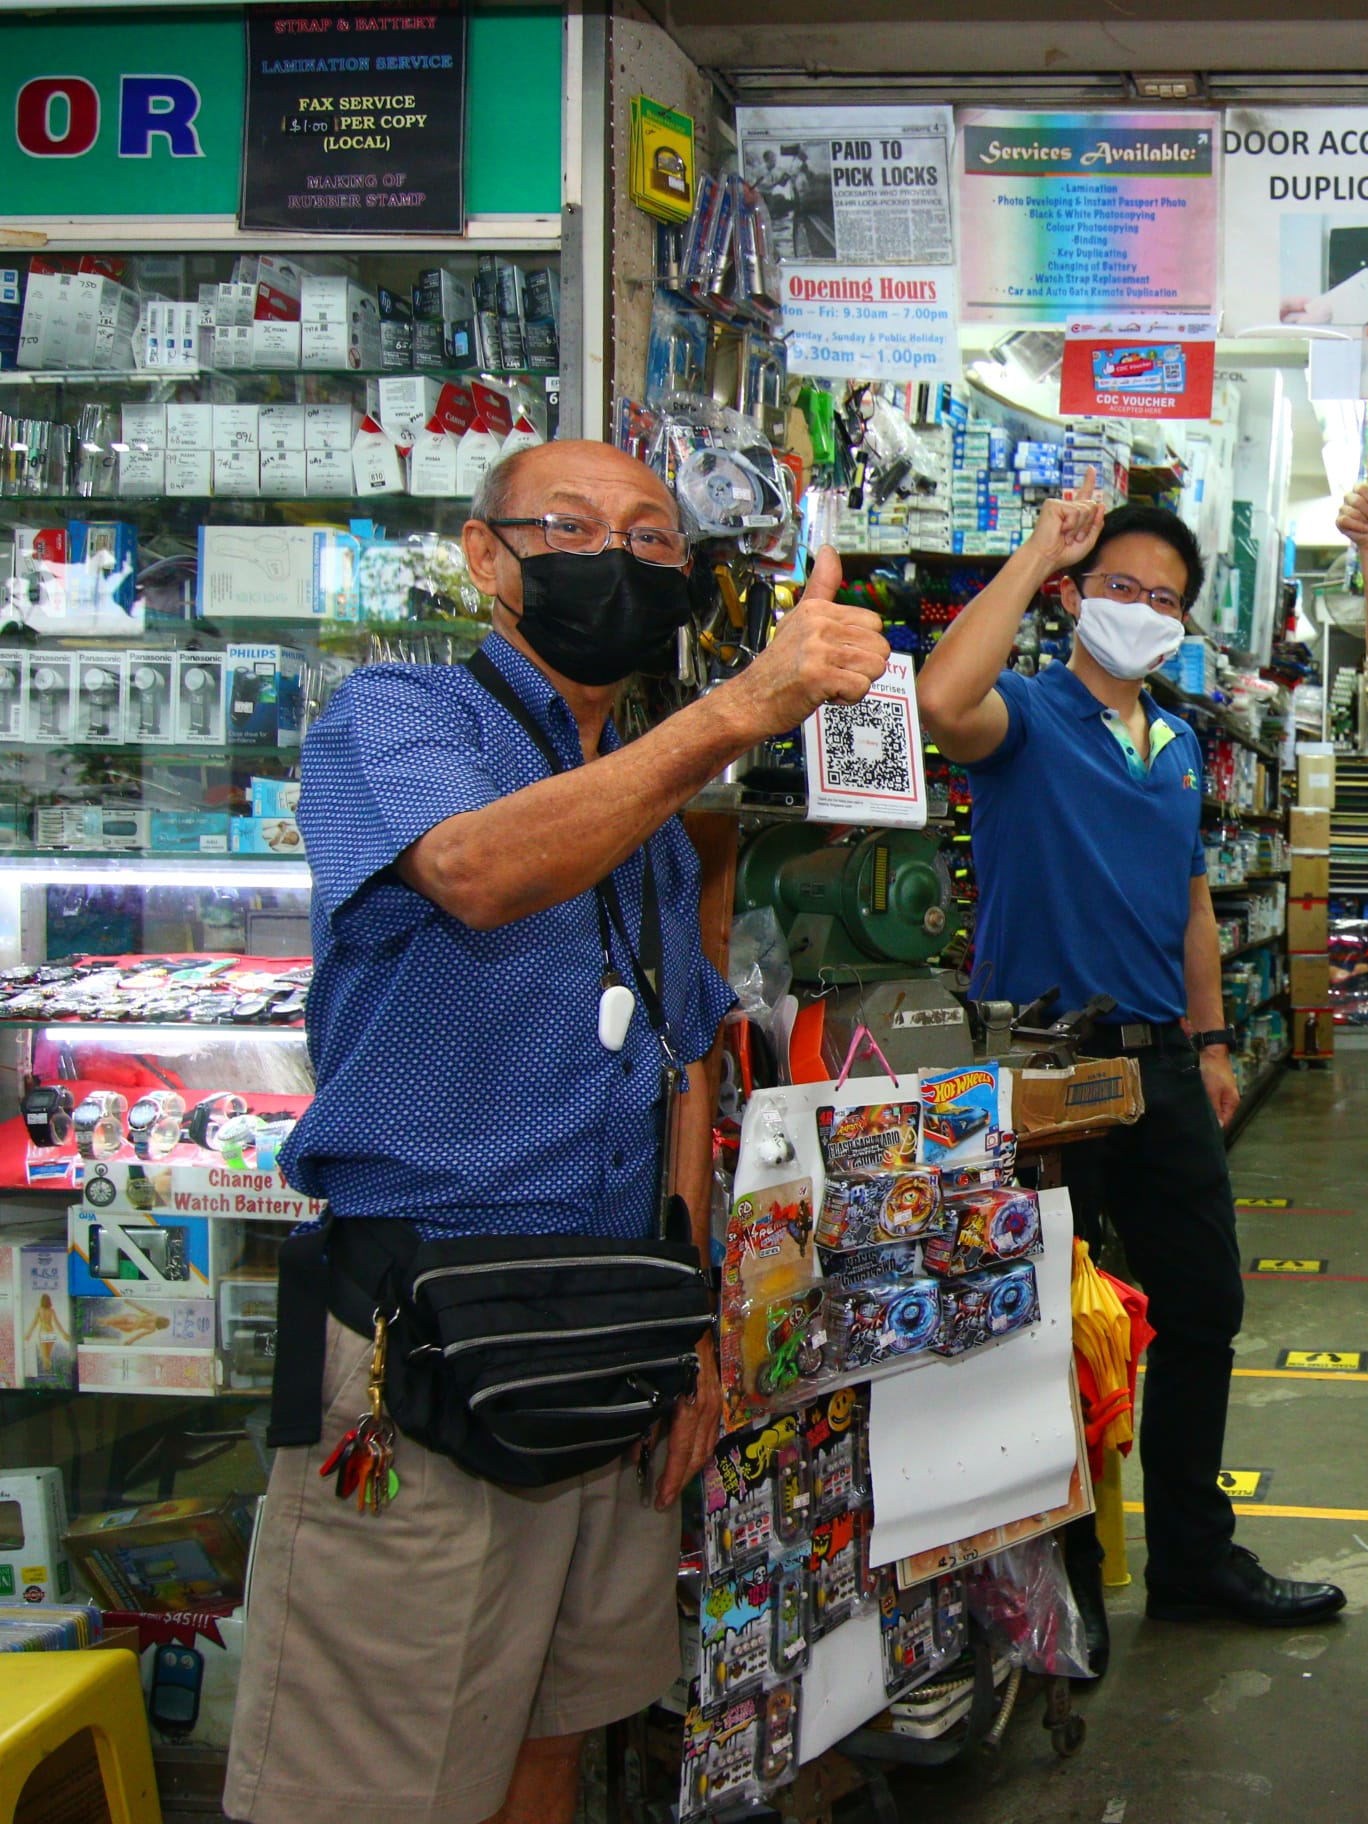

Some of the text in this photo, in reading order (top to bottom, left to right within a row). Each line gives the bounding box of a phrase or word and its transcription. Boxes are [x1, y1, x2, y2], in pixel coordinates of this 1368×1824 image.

[274, 16, 438, 34] STRAP & BATTERY
[262, 54, 453, 74] LAMINATION SERVICE
[299, 95, 415, 112] FAX SERVICE
[340, 114, 428, 131] PER COPY
[323, 136, 391, 152] (LOCAL)
[831, 140, 903, 161] PAID TO
[1222, 130, 1309, 155] DOOR
[979, 140, 1196, 166] Services Available:
[306, 173, 407, 190] MAKING OF
[832, 166, 938, 187] PICK LOCKS
[1066, 183, 1118, 194] Lamination
[288, 192, 426, 209] RUBBER STAMP
[997, 196, 1024, 207] Photo
[1026, 196, 1073, 208] Developing
[1083, 197, 1116, 207] Instant
[1119, 197, 1159, 209] Passport
[1160, 198, 1187, 208] Photo
[1029, 209, 1155, 221] Black White Photocopying
[1046, 222, 1139, 234] Colour Photocopying
[1057, 248, 1128, 260] Key Duplicating
[1048, 261, 1137, 273] Changing of Battery
[1035, 273, 1150, 285] Watch Strap Replacement
[789, 275, 938, 302] Opening Hours
[1008, 286, 1024, 296] Car
[1026, 286, 1043, 296] and
[1045, 286, 1067, 296] Auto
[1090, 286, 1124, 297] Remote
[1125, 287, 1177, 298] Duplication
[779, 304, 803, 316] Mon
[843, 307, 888, 319] 9.30am
[903, 308, 949, 322] 7.00pm
[832, 332, 865, 345] Sunday
[878, 333, 907, 343] Public
[792, 344, 937, 367] 9.30am 1.00pm
[1096, 393, 1176, 408] CDC VOUCHER
[1108, 405, 1163, 415] ACCEPTED HERE
[29, 654, 72, 664] Panasonic
[79, 654, 122, 664] Panasonic
[129, 652, 173, 663] Panasonic
[179, 654, 223, 664] Panasonic
[229, 648, 277, 660] PHILIPS
[934, 1071, 992, 1103] HOT WHEELS
[208, 1168, 273, 1190] Change
[175, 1192, 301, 1215] Watch Battery
